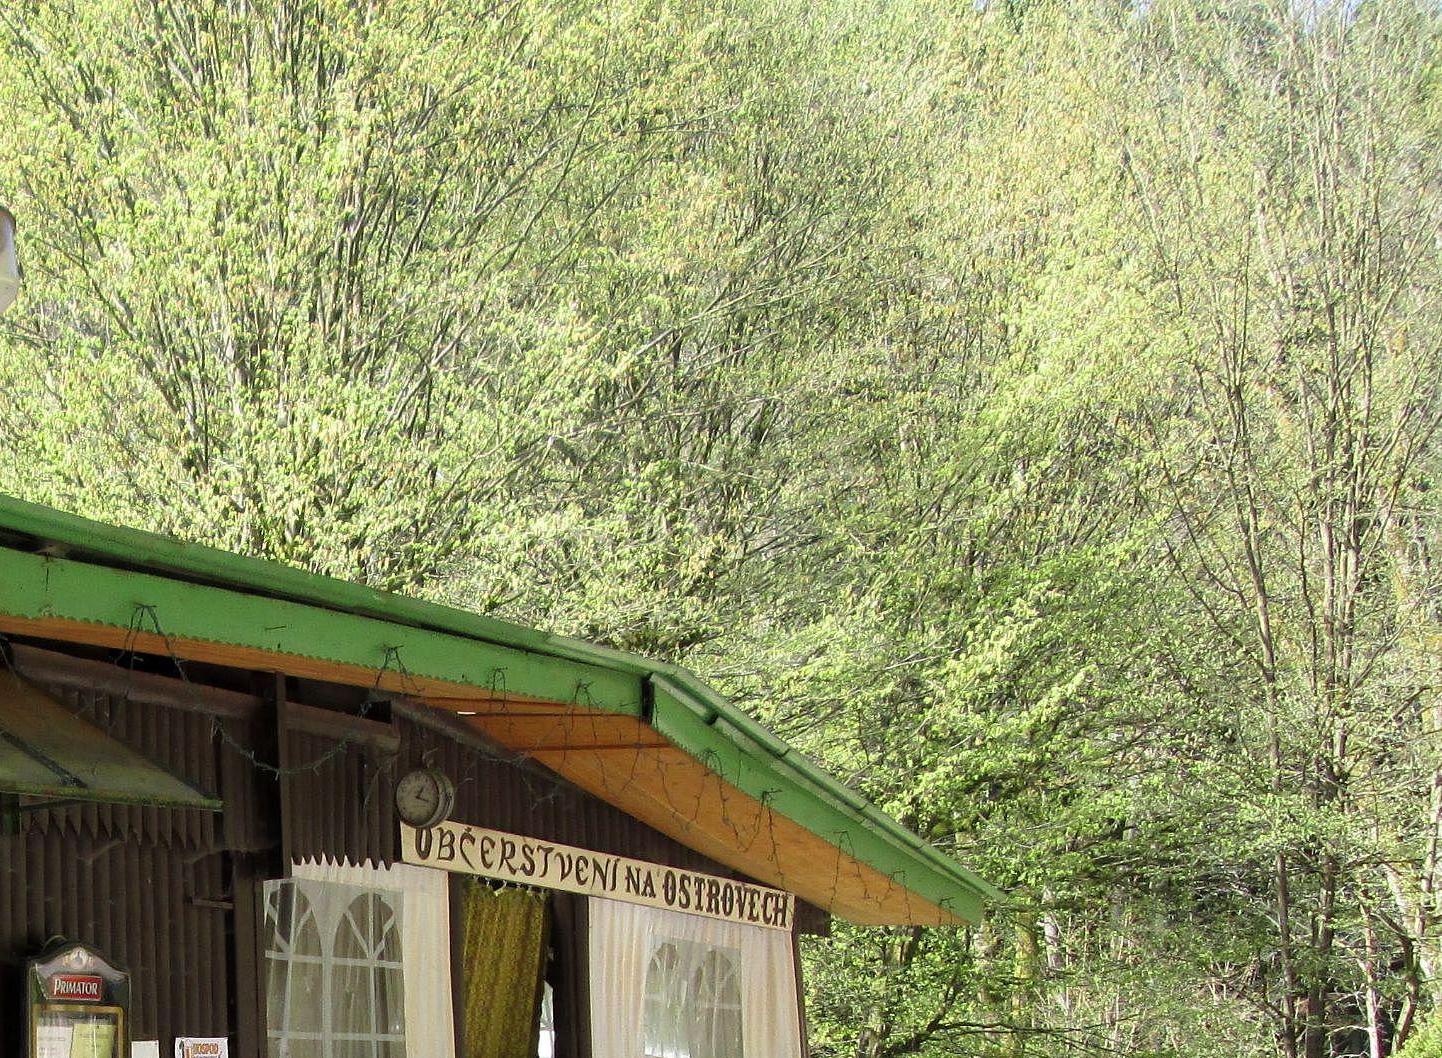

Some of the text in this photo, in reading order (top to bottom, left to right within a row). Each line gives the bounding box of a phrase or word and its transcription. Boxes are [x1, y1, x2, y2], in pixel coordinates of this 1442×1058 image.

[415, 826, 788, 928] OBČERSTVENÍ NA OSTROVECH
[53, 978, 98, 995] PRIMATOR
